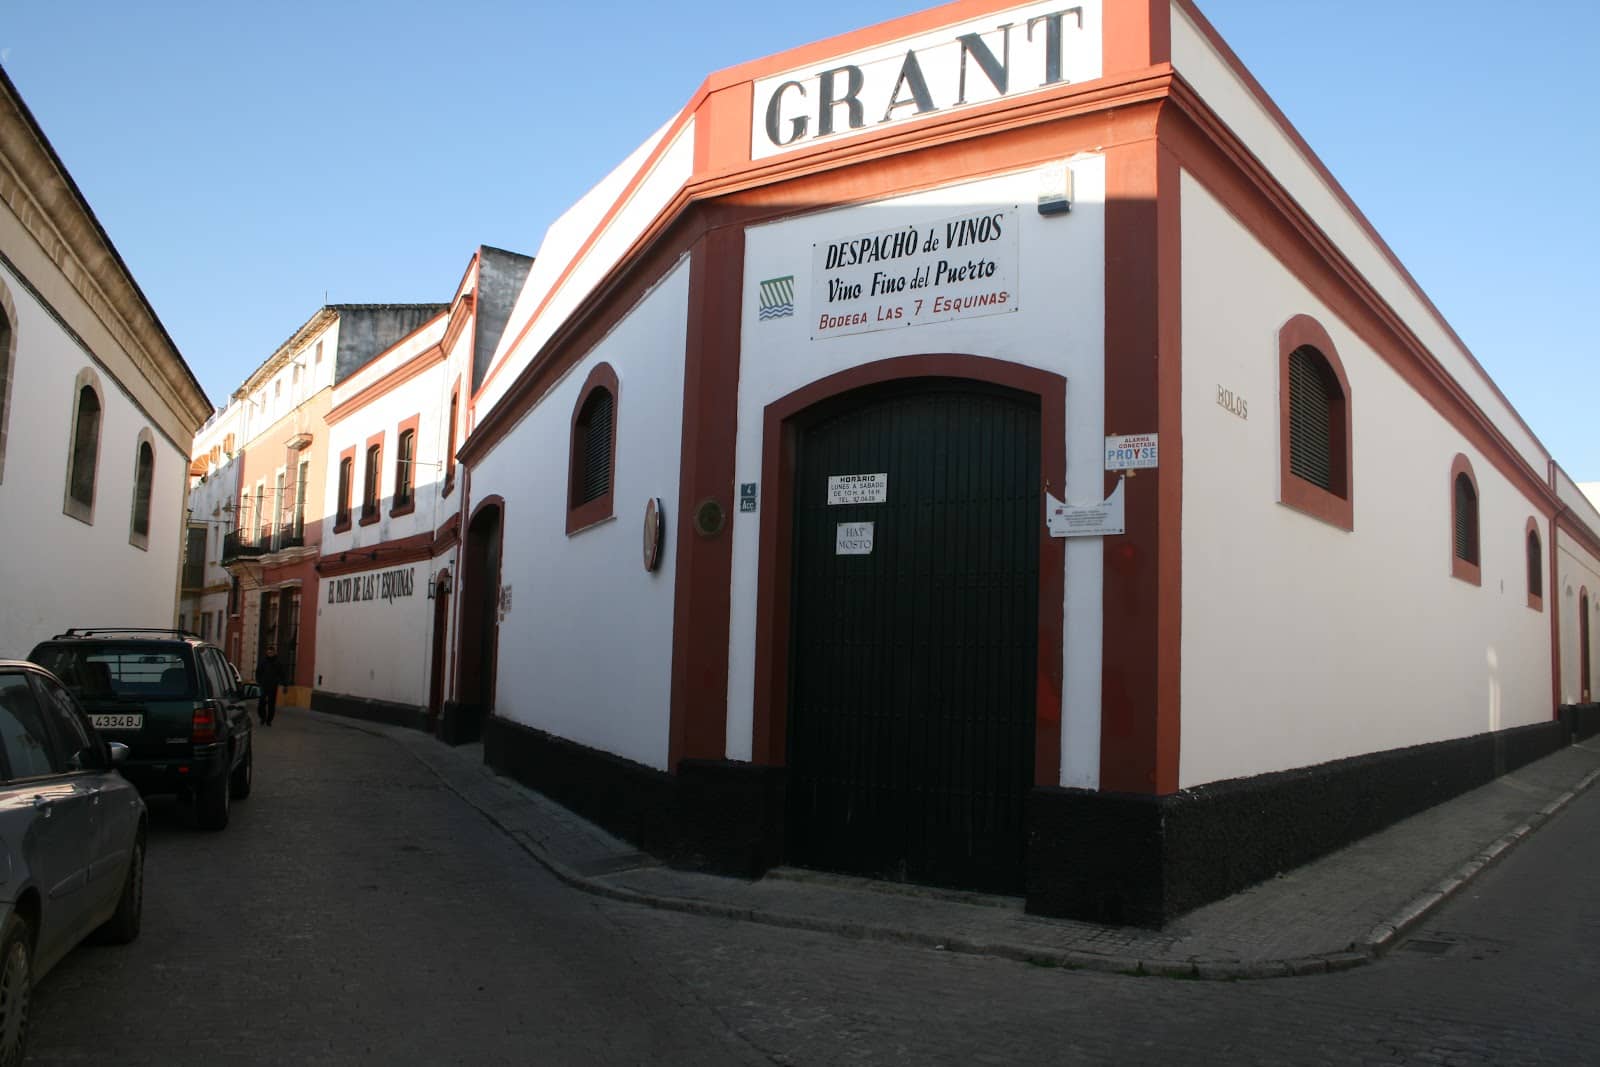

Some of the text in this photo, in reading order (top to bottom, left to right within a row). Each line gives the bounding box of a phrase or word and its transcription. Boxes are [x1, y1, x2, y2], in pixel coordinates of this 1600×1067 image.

[765, 6, 1082, 147] GRANT
[825, 214, 1003, 270] DESPACHO de VINOS
[828, 258, 996, 303] Vino Fino del Puerto
[877, 305, 903, 321] LAS
[914, 300, 923, 315] 7
[1107, 447, 1157, 460] PROYSE
[1118, 441, 1156, 449] CONECTADA
[840, 475, 875, 483] HORARIO
[846, 527, 866, 537] HAY
[839, 540, 871, 550] MOSTO
[328, 567, 415, 605] EL PATIO DE LAS 7 ESQUINAS
